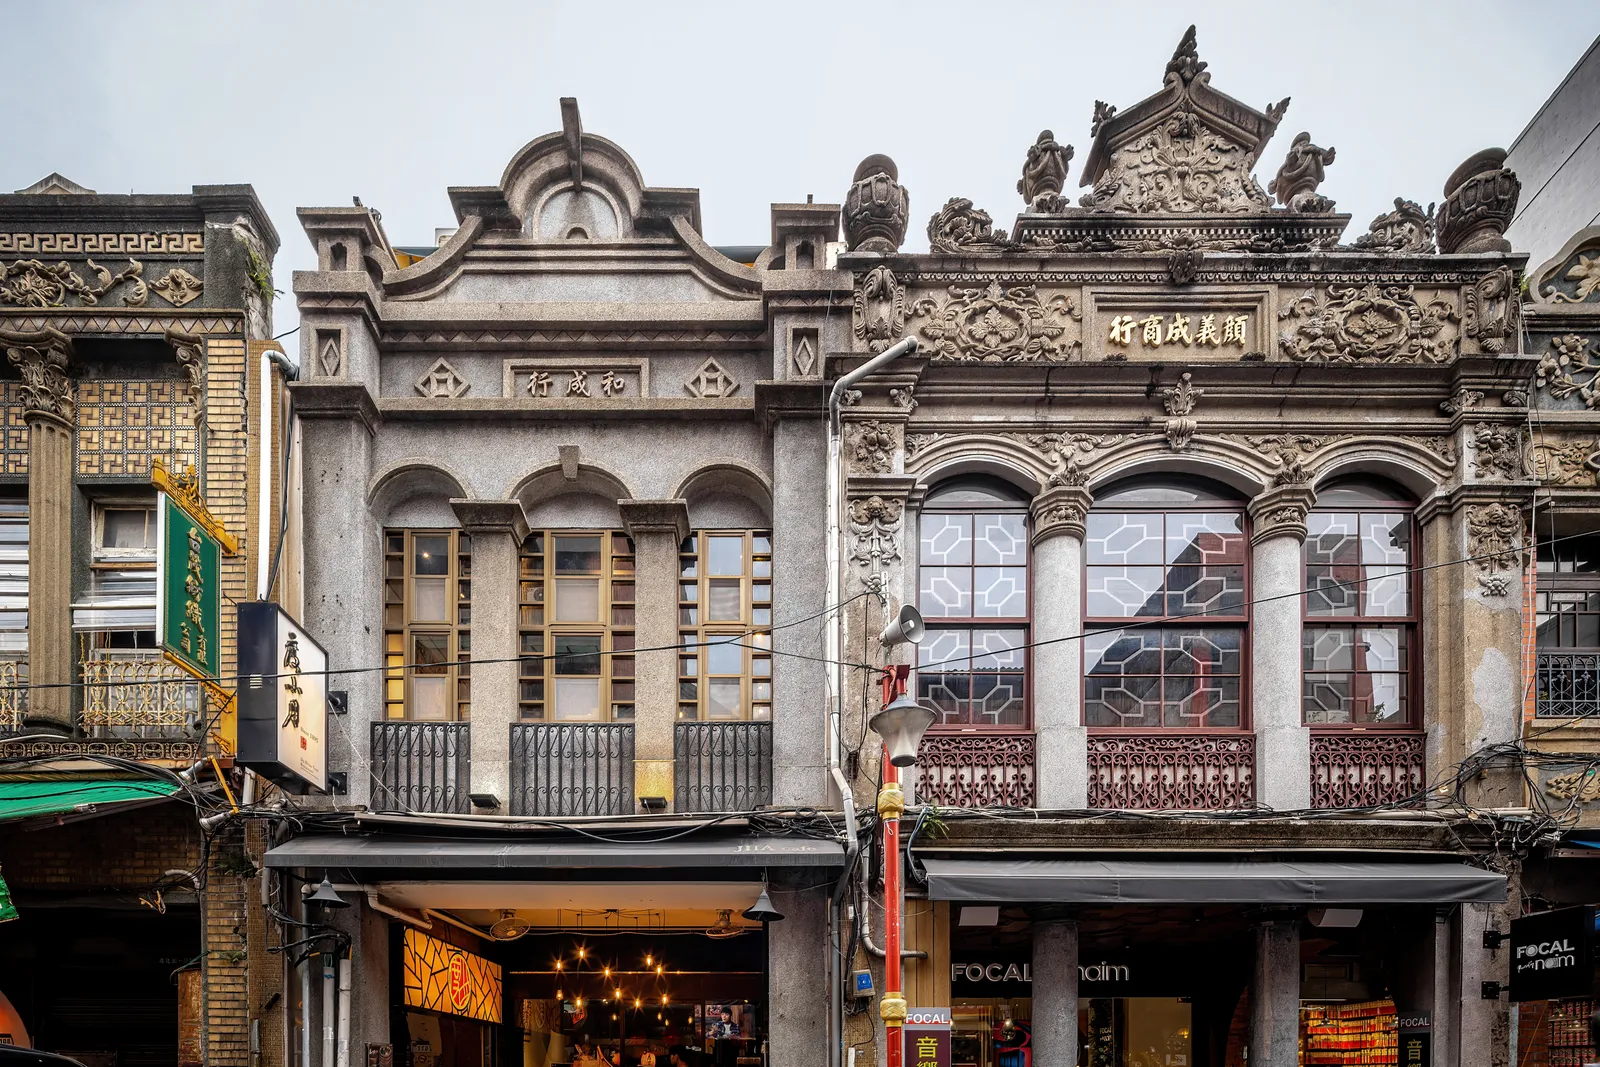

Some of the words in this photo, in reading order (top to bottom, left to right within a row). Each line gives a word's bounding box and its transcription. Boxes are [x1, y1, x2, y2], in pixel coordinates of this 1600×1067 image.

[1517, 939, 1575, 959] FOCAL
[952, 963, 1032, 982] FOCAL
[906, 1013, 949, 1024] FOCAL
[1400, 1017, 1430, 1027] FOCAL
